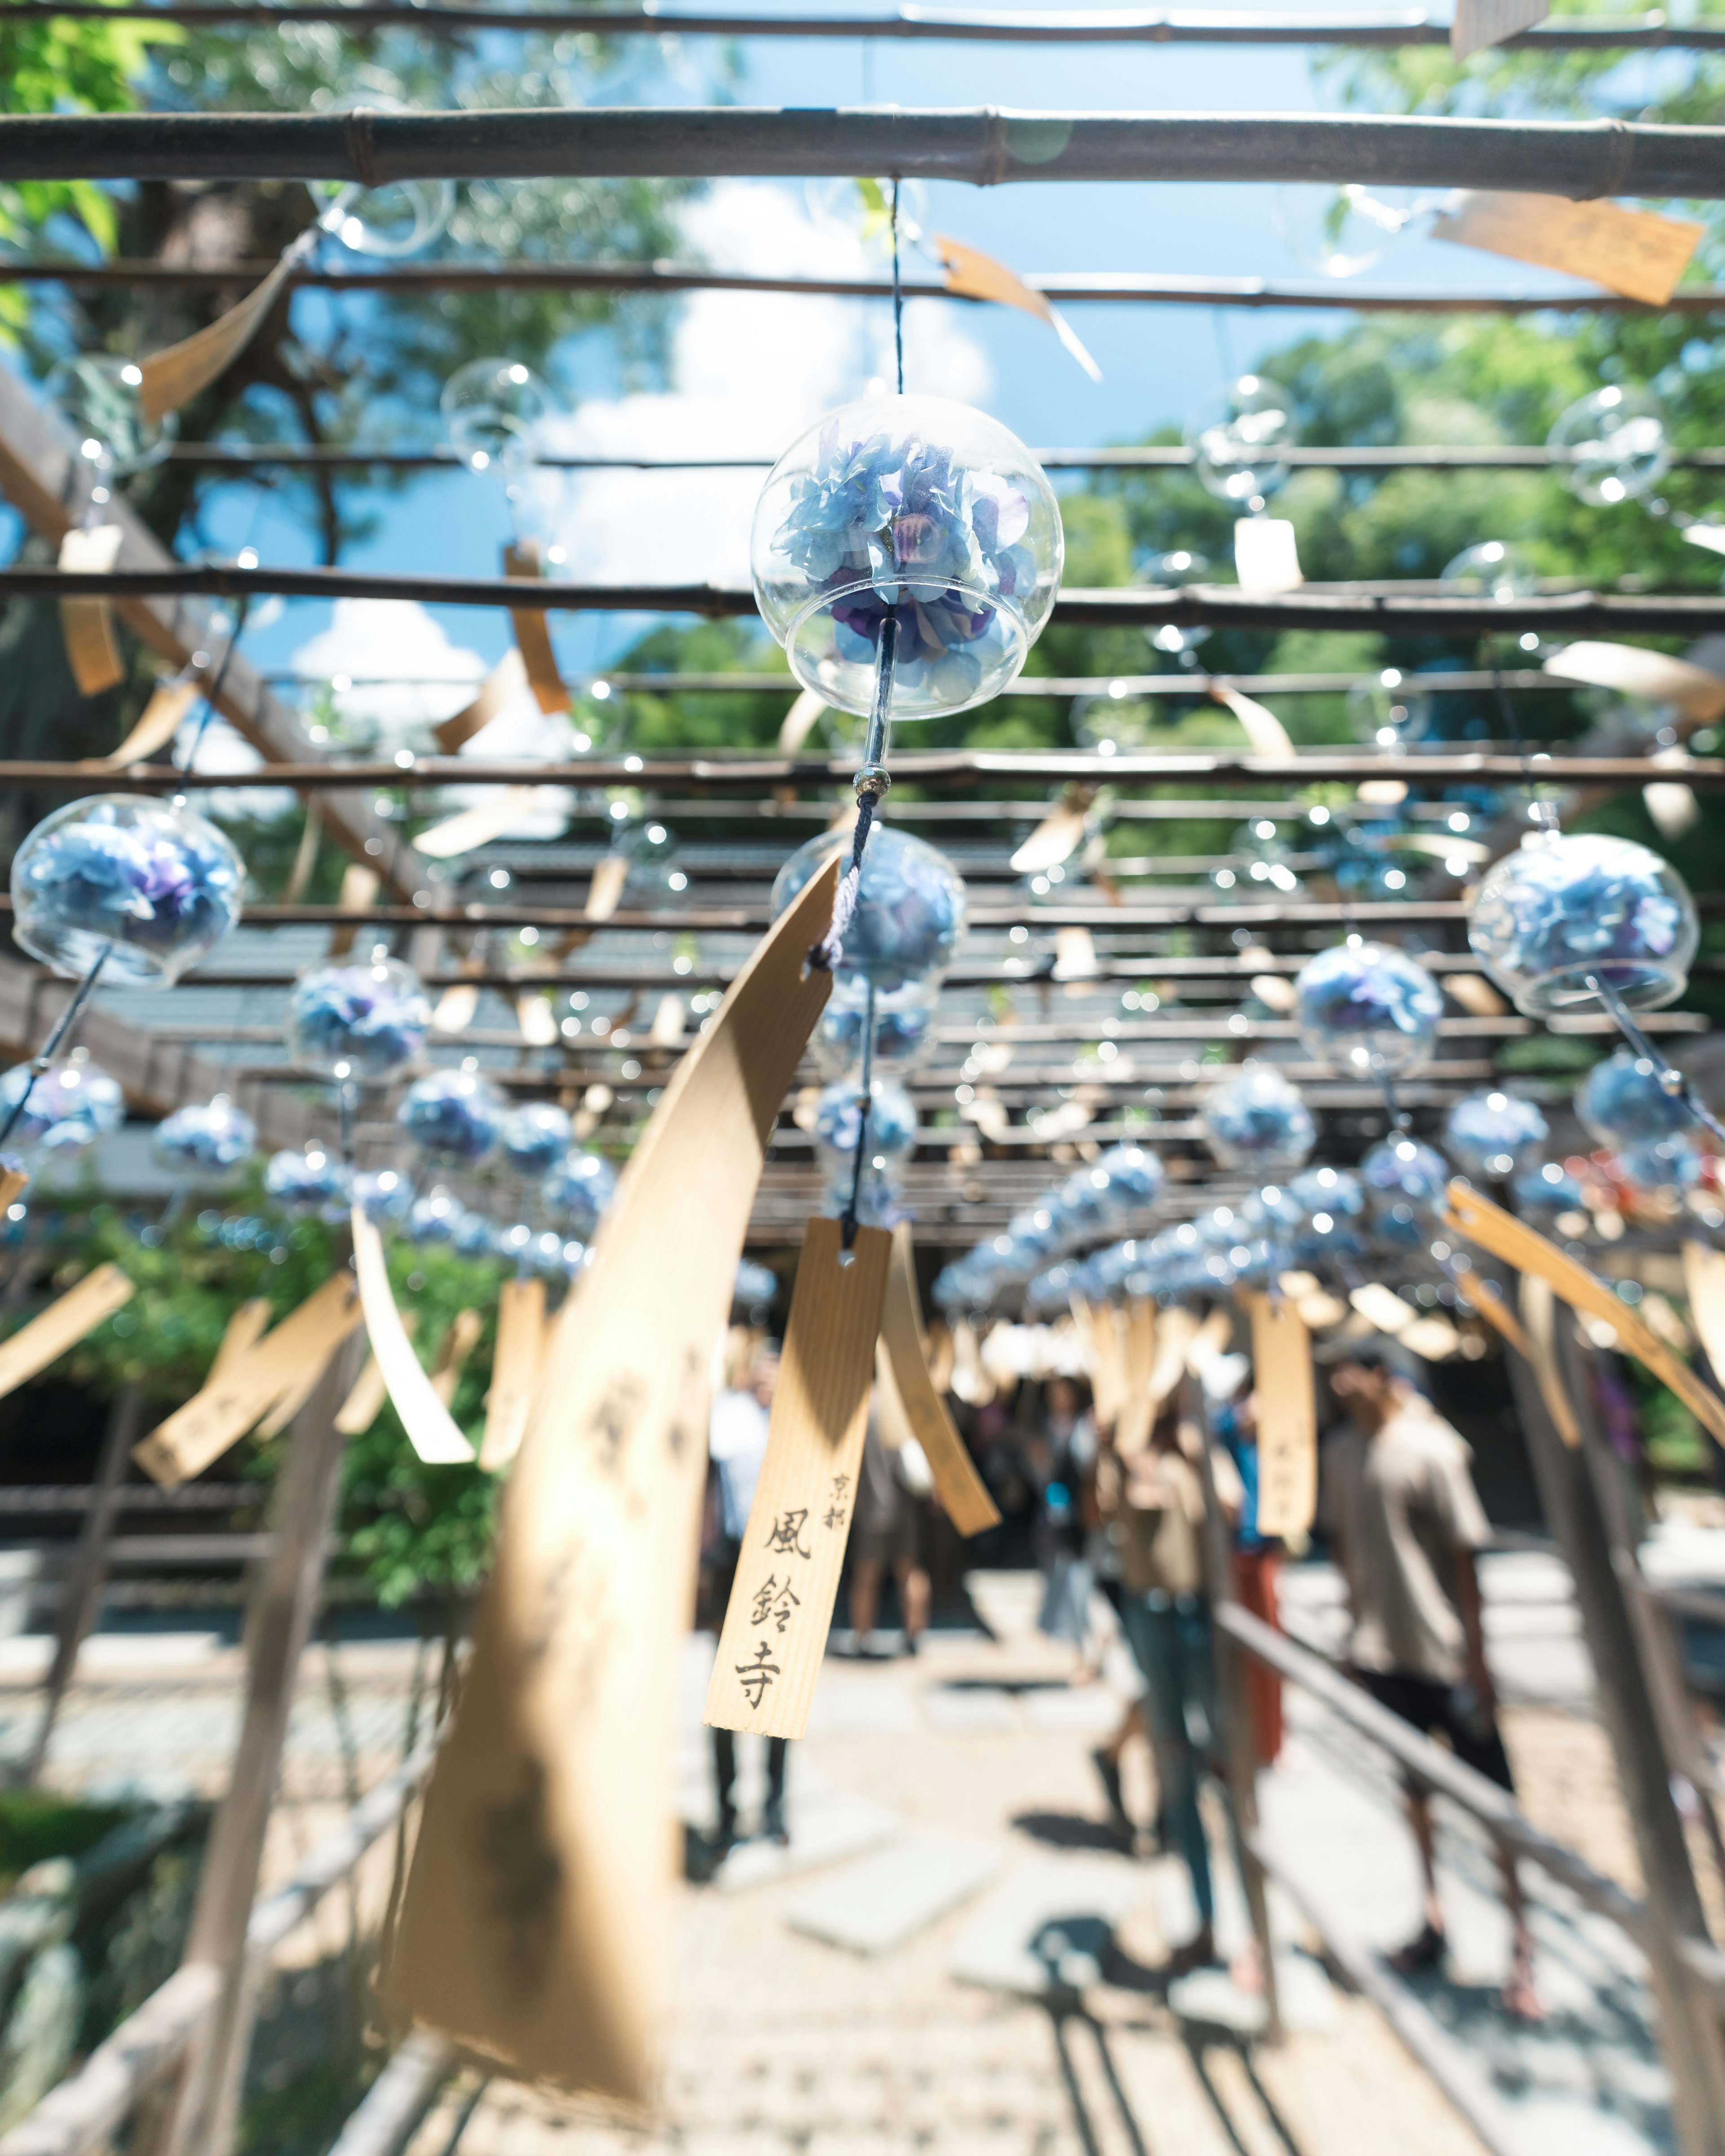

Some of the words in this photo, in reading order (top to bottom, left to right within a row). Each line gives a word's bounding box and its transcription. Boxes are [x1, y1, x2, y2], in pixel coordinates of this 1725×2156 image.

[823, 1473, 850, 1530] 京都
[735, 1508, 811, 1710] 風鈴寺
